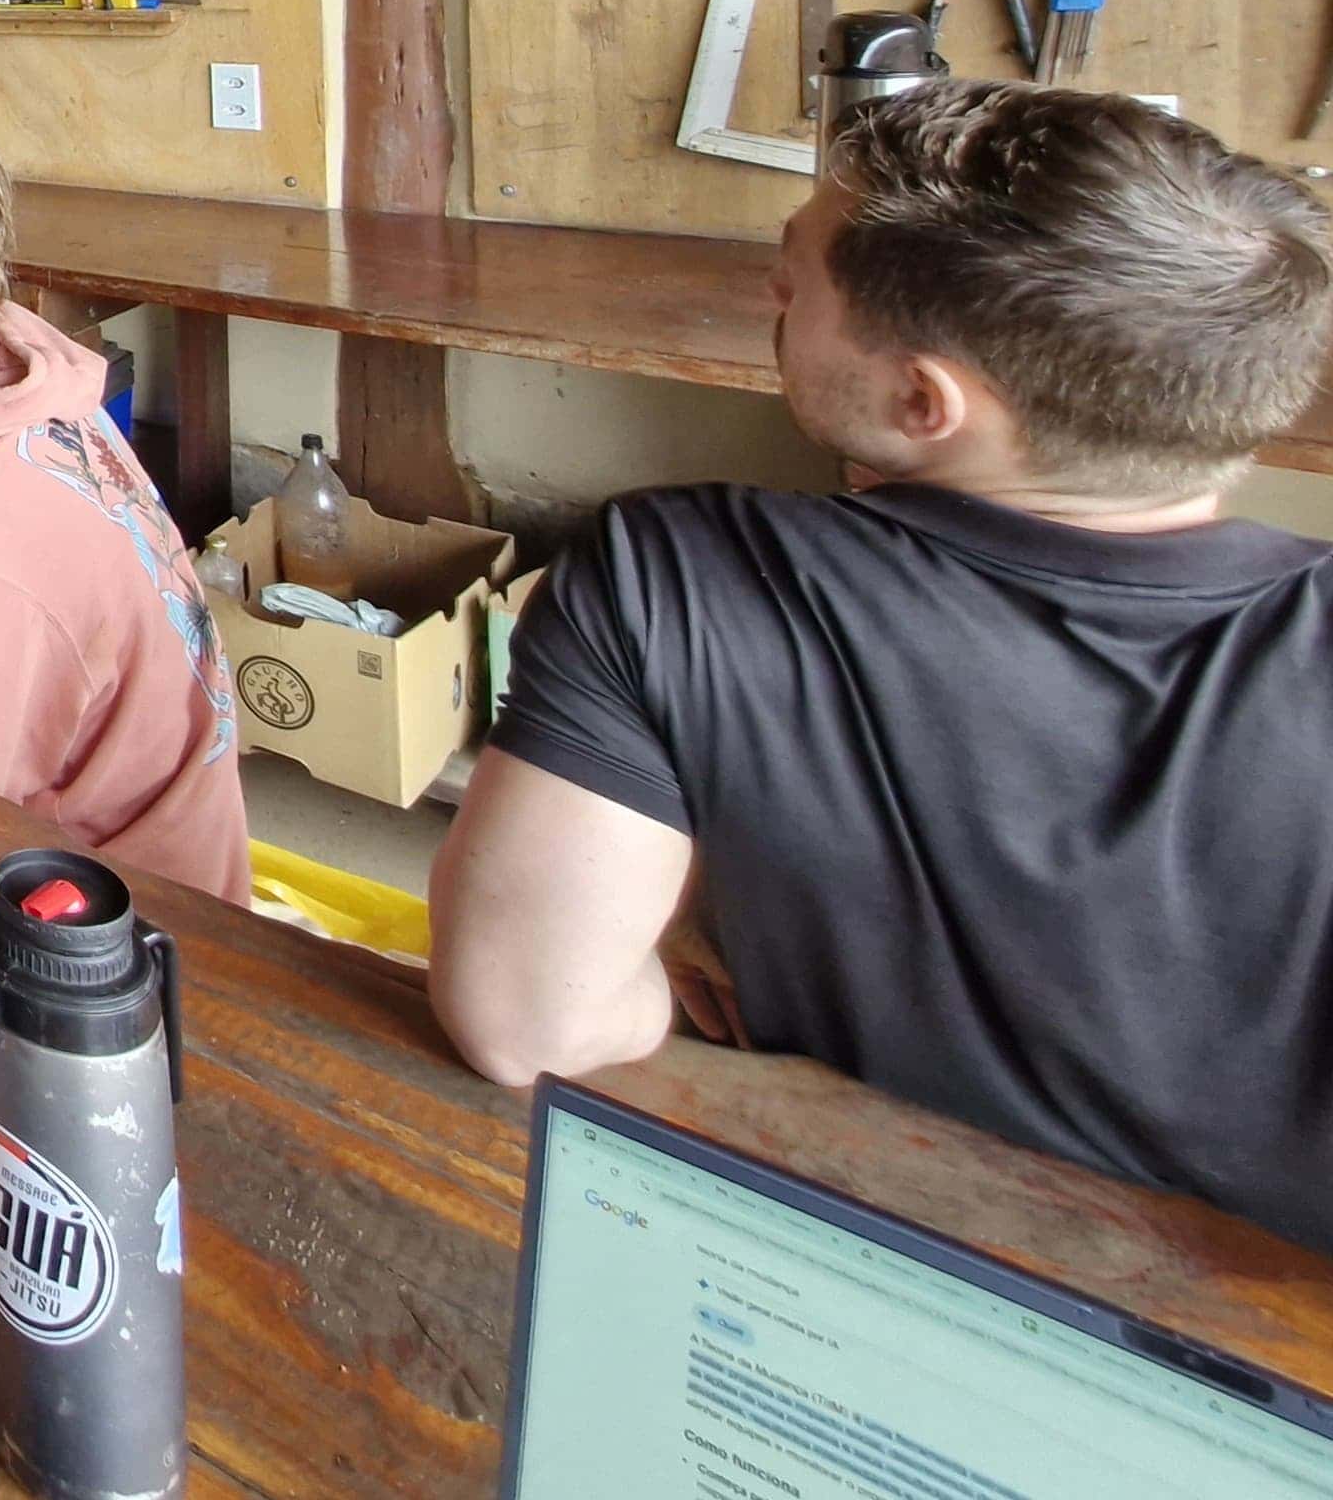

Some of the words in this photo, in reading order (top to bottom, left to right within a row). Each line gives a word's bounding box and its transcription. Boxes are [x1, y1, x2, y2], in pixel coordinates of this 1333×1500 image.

[245, 665, 305, 702] GAUCHO
[584, 1188, 649, 1230] Google
[683, 1427, 728, 1461] Como
[732, 1452, 802, 1500] funciona
